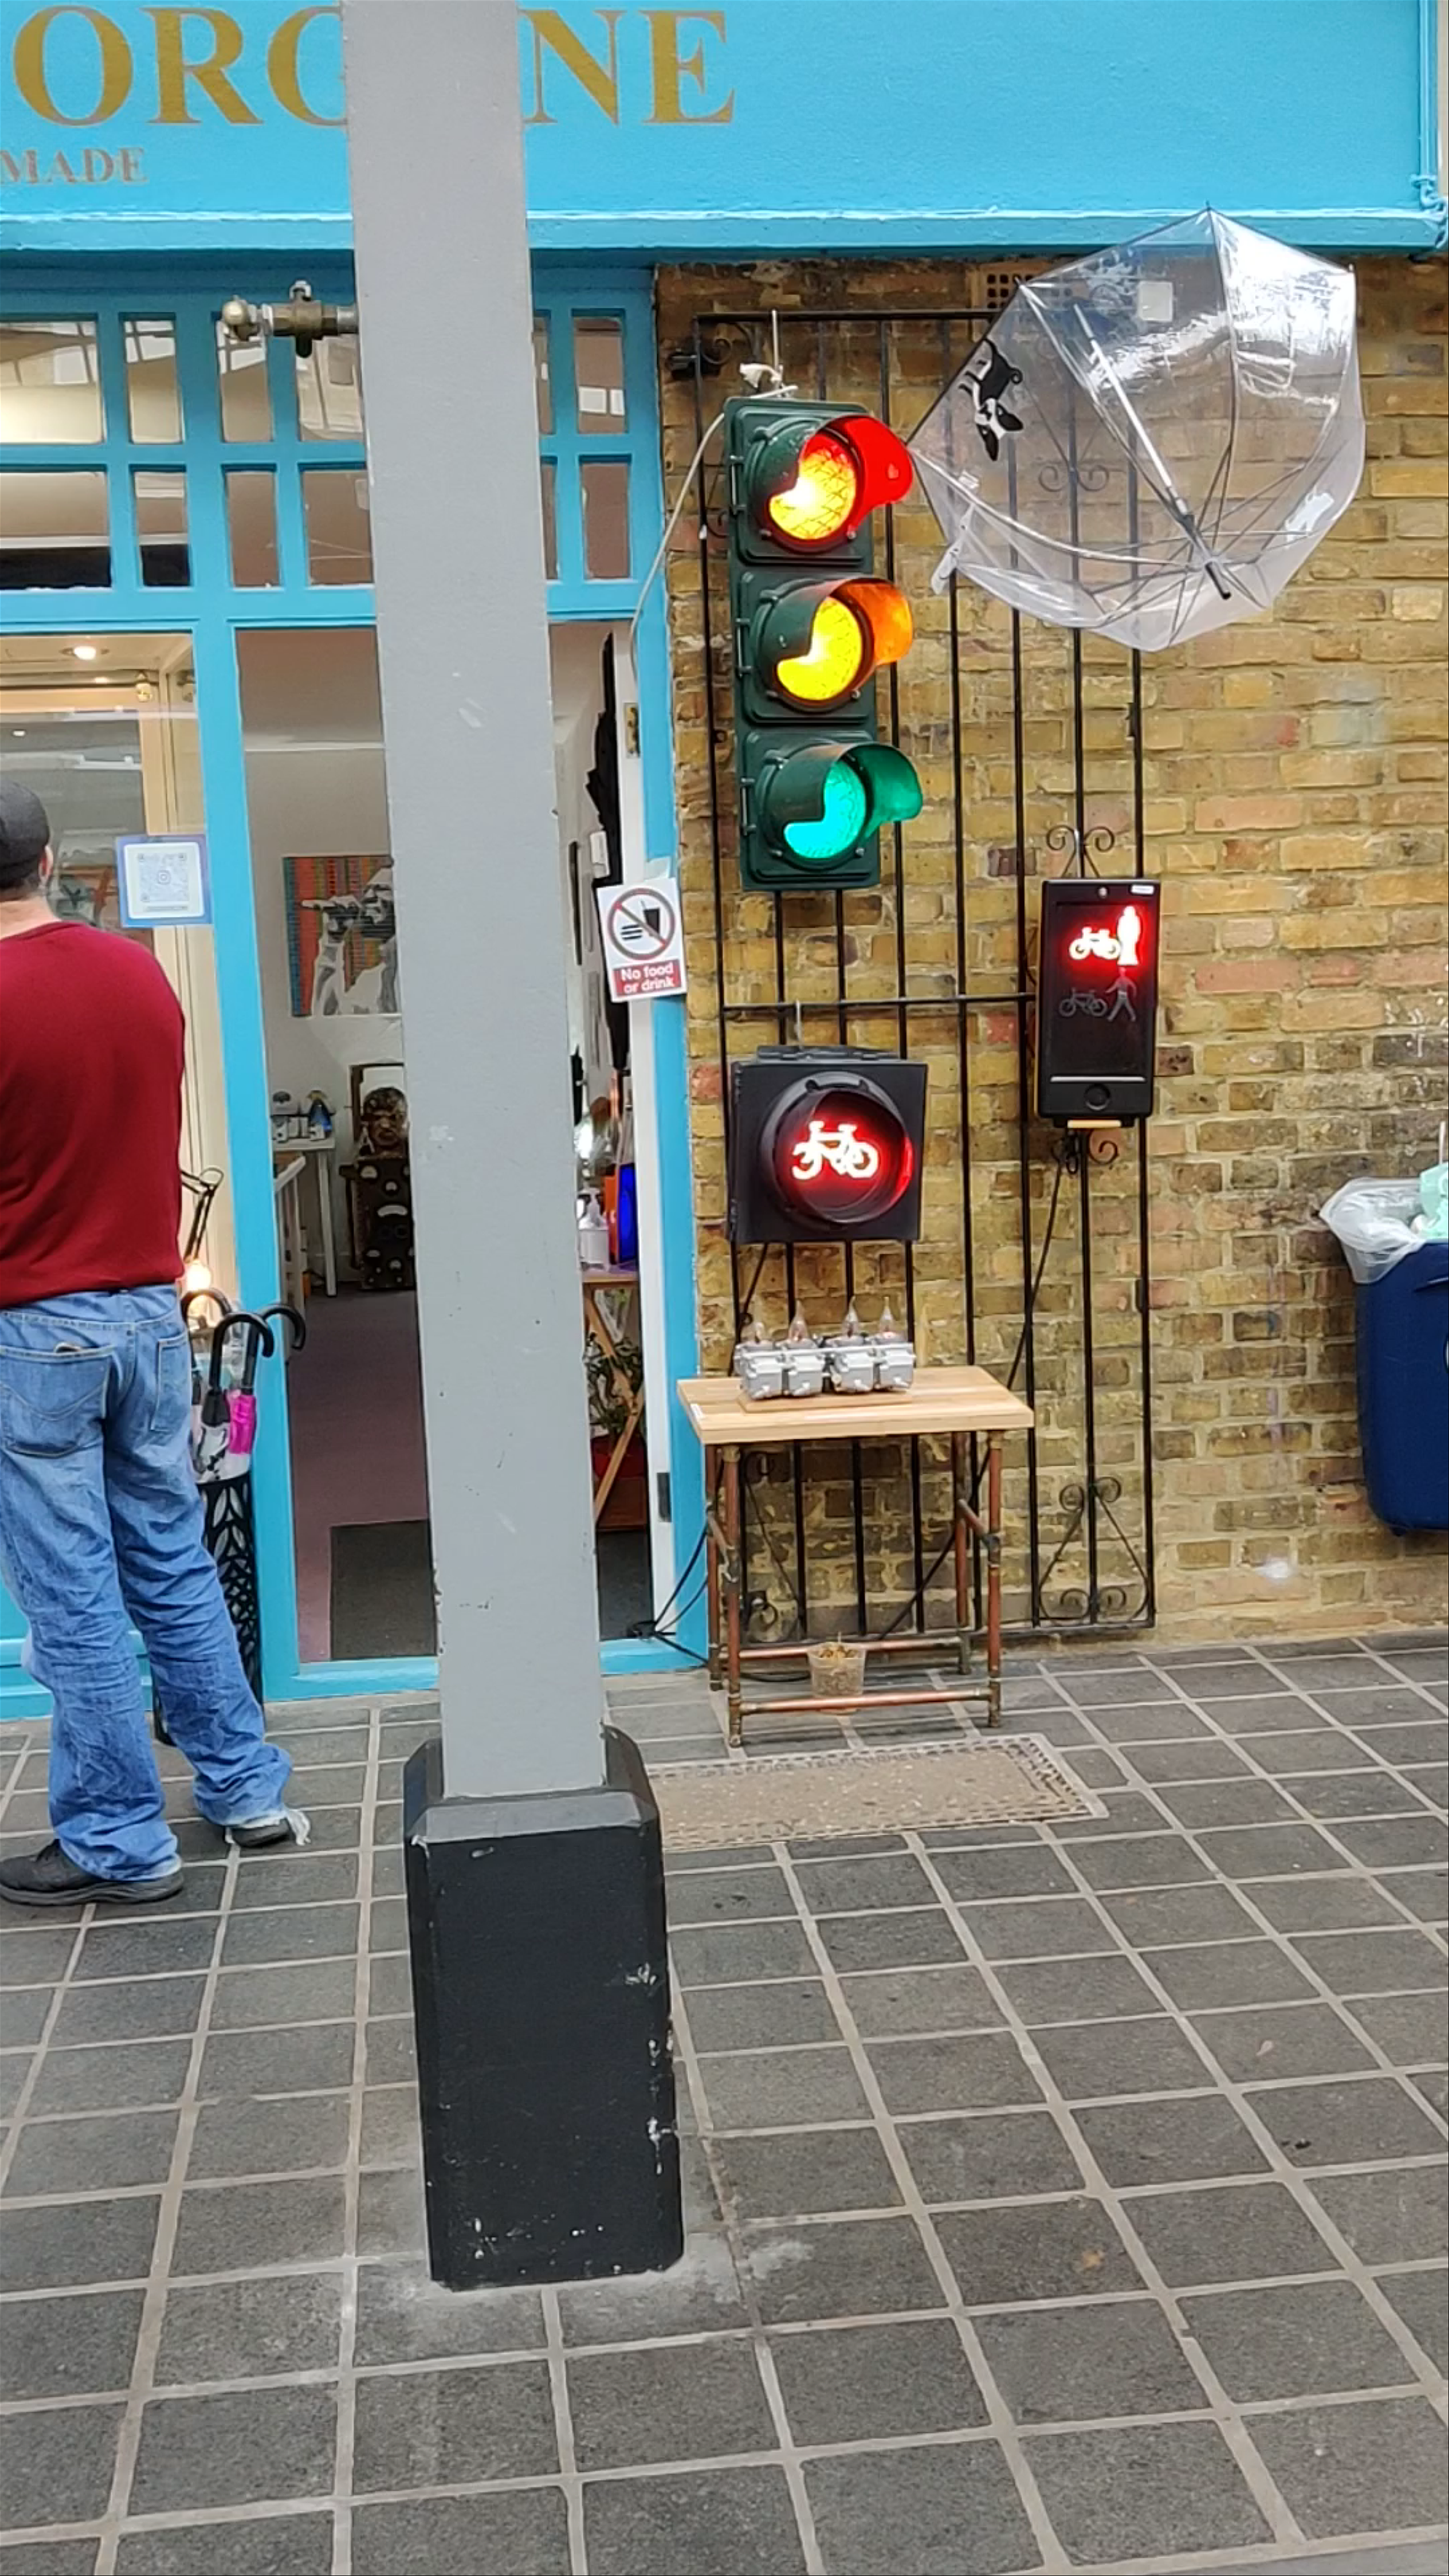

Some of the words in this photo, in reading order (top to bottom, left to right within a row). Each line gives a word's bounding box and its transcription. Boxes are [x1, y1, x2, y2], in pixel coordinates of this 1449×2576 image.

[12, 5, 734, 126] ORGNE
[621, 968, 641, 981] No
[643, 962, 674, 978] food
[624, 983, 639, 993] or
[641, 977, 675, 991] drink
